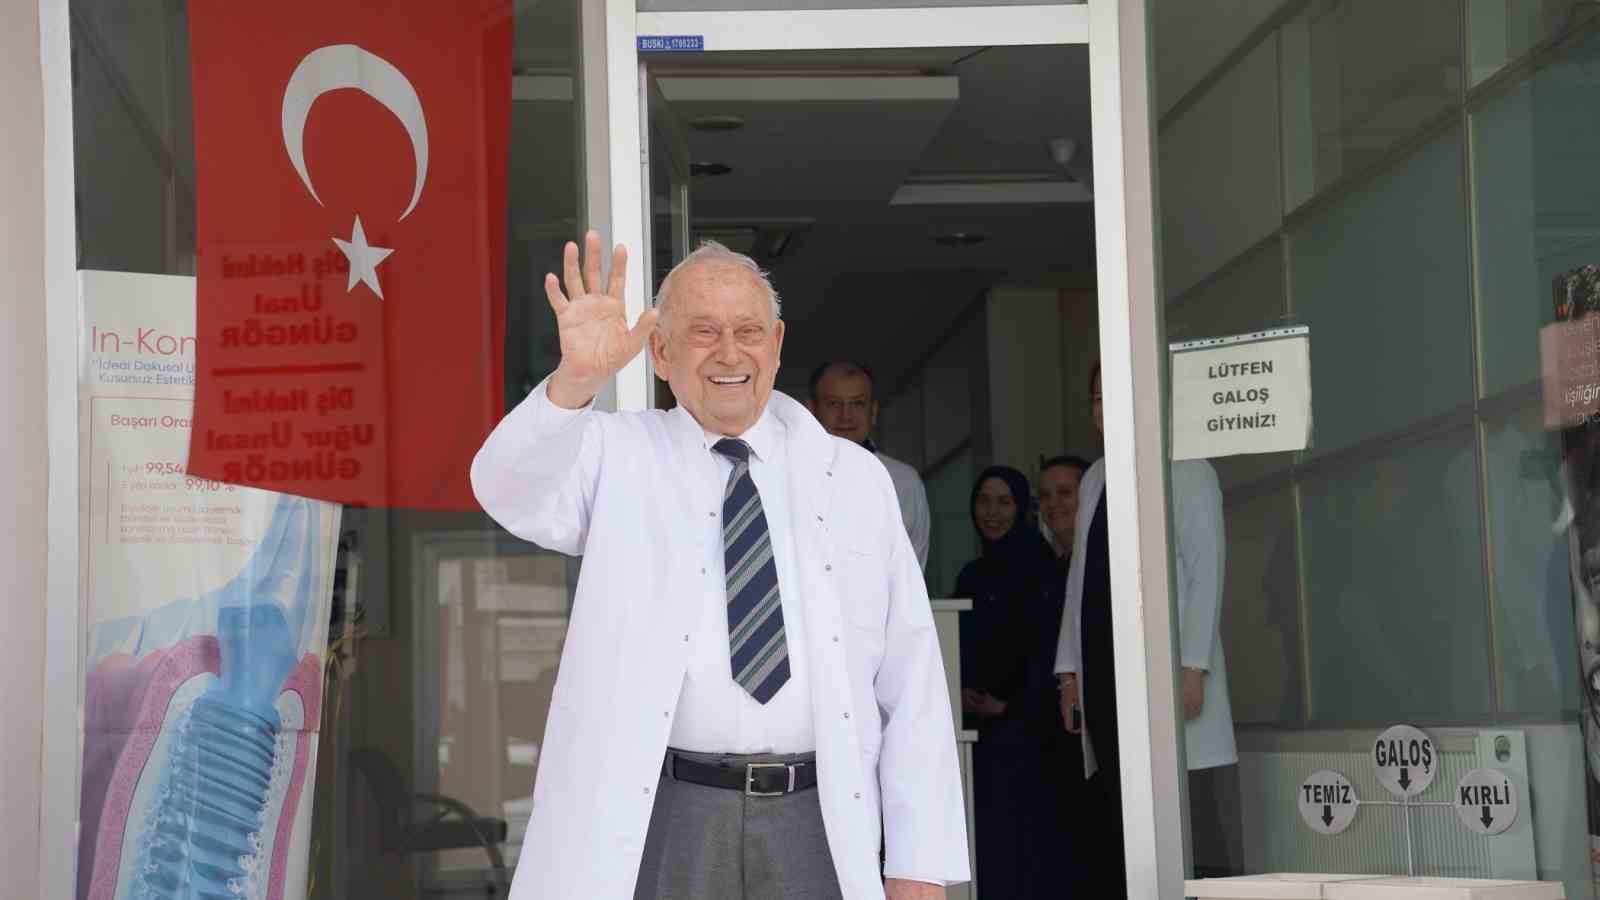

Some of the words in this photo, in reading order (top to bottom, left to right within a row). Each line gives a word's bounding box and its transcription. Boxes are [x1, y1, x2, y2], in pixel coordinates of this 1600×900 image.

[1208, 360, 1274, 379] LÜTFEN
[1212, 387, 1270, 404] GALOŞ
[111, 414, 157, 429] Başarı
[1207, 412, 1276, 431] GİYİNİZ!
[1375, 739, 1432, 774] GALOŞ
[1304, 780, 1352, 804] TEMİZ
[1460, 780, 1511, 805] KIRLİ
